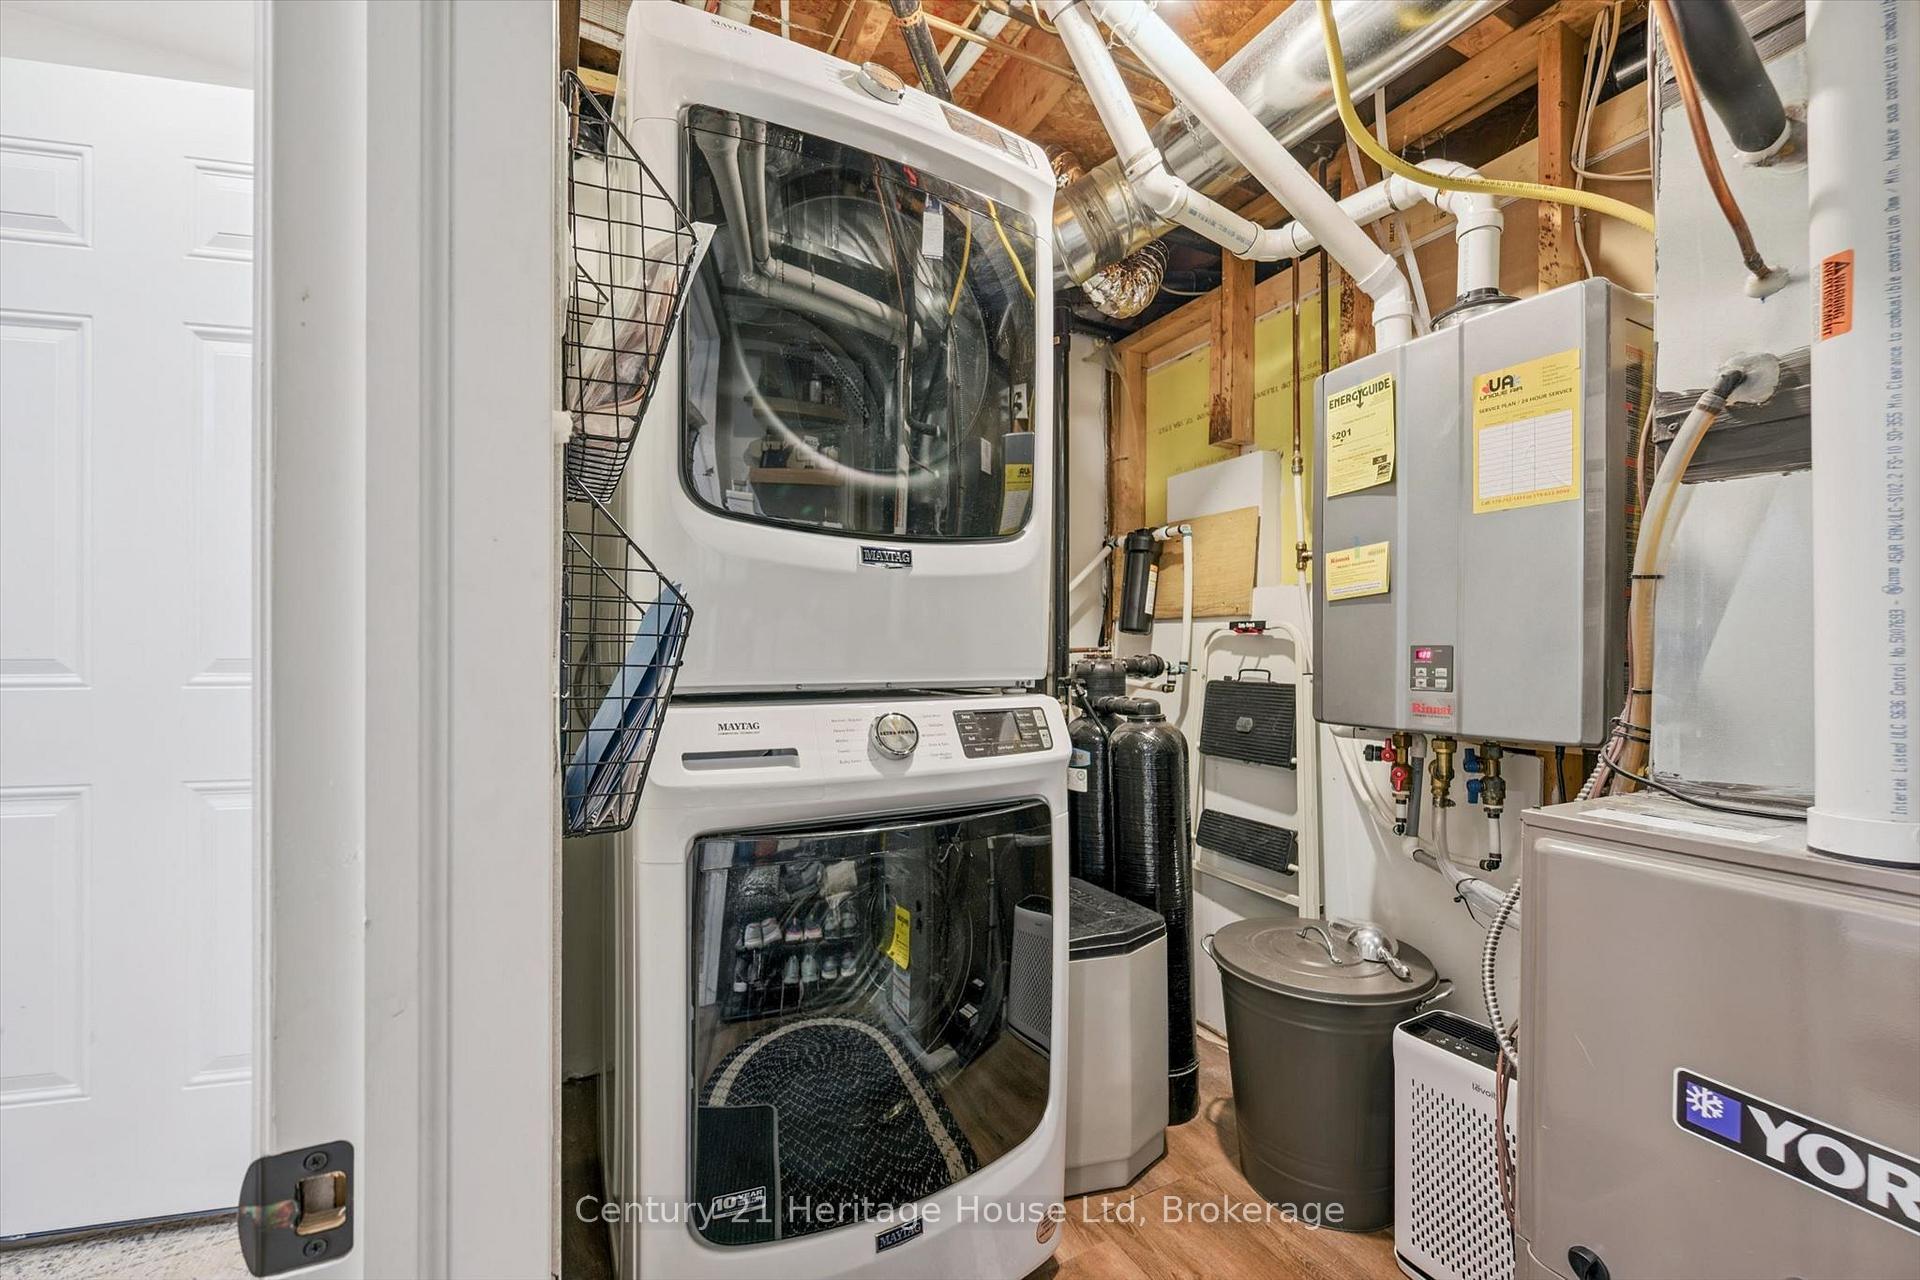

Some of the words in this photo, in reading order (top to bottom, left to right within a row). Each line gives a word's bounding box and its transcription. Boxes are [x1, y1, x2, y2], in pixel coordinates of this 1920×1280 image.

[1882, 44, 1900, 100] construction
[1886, 104, 1900, 123] sous
[1885, 214, 1902, 273] construction
[1822, 262, 1834, 337] AVERTISSEMENT
[1832, 272, 1847, 319] WARNING
[1884, 277, 1903, 328] combustible
[1887, 332, 1902, 342] to
[1489, 374, 1514, 392] UA
[1886, 345, 1903, 390] Clearance
[1887, 393, 1904, 408] Min
[863, 549, 910, 563] MAYTAG
[1889, 662, 1907, 696] Control
[1411, 702, 1452, 716] Rinnai
[717, 722, 760, 731] MAYTAG
[1890, 742, 1908, 772] Listed
[1747, 1104, 1920, 1223] YOR
